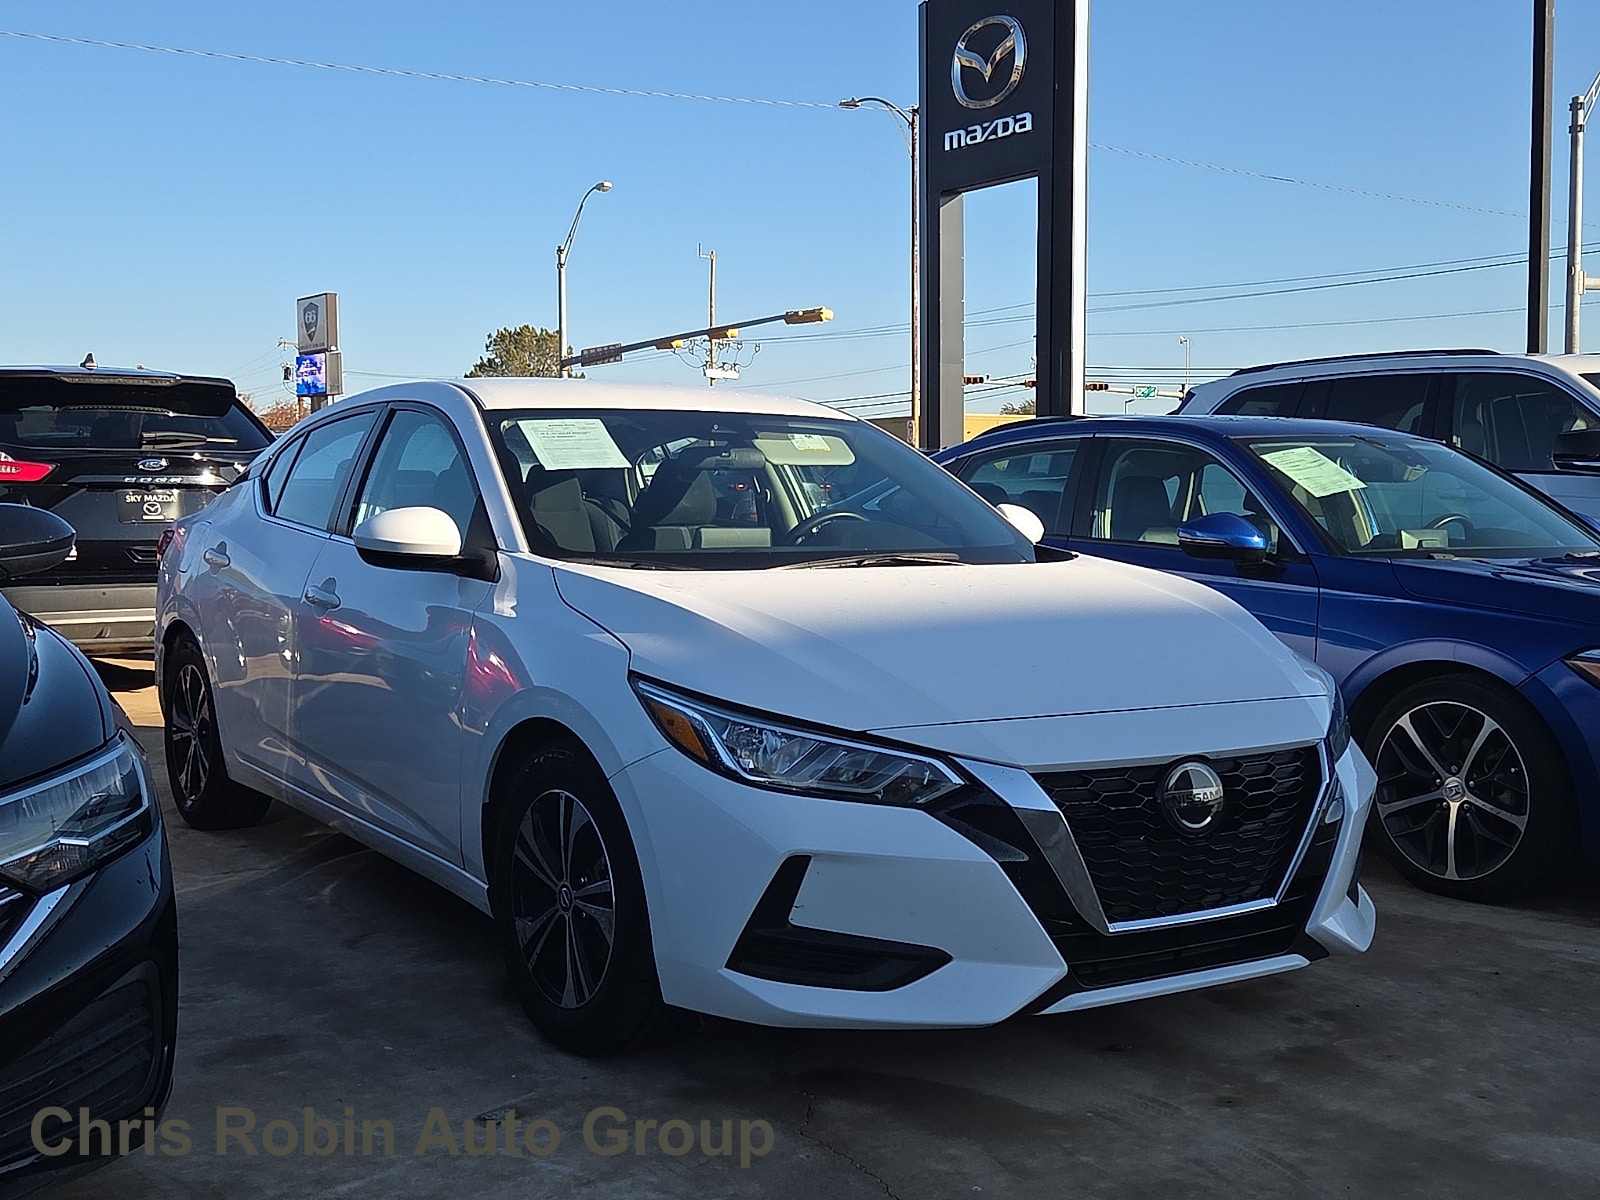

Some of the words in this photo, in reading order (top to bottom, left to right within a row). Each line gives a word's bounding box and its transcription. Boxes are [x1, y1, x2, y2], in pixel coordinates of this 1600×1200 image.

[304, 311, 316, 324] 66
[125, 494, 142, 502] SKY
[144, 494, 177, 502] MAZDA
